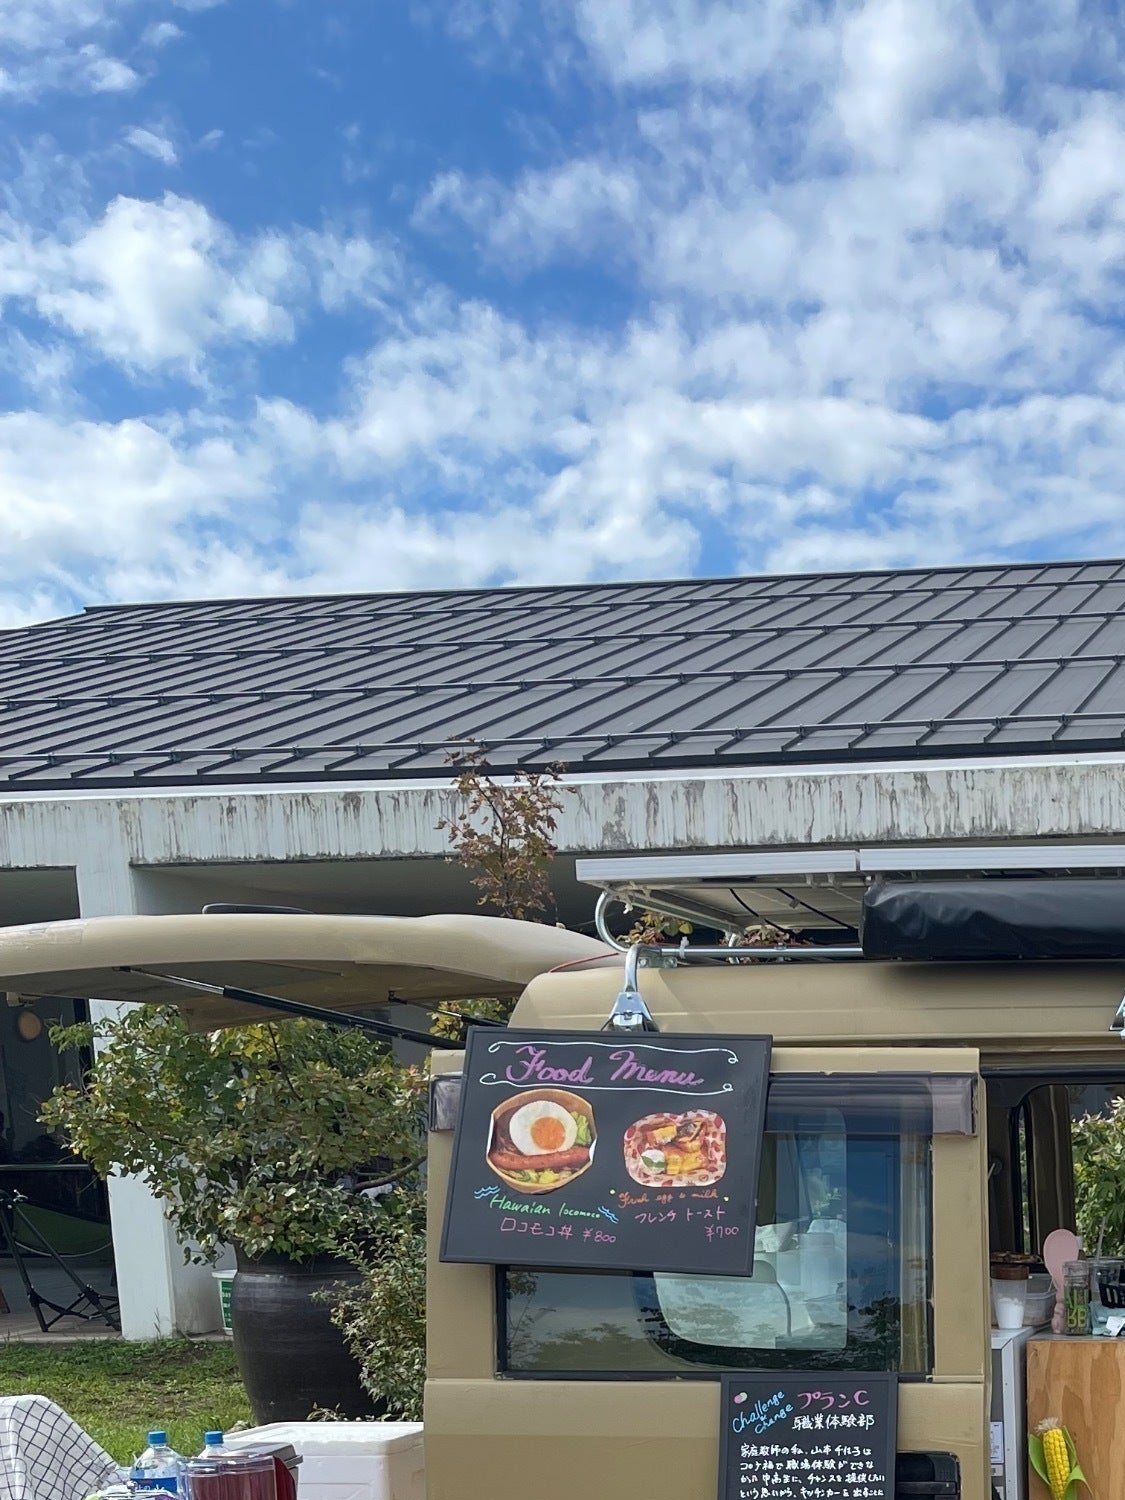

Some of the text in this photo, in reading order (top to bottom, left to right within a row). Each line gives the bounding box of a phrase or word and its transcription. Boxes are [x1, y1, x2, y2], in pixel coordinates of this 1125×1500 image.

[506, 1045, 704, 1085] Food Menu
[732, 1391, 784, 1433] Challenge
[792, 1413, 874, 1431] 職業体験部
